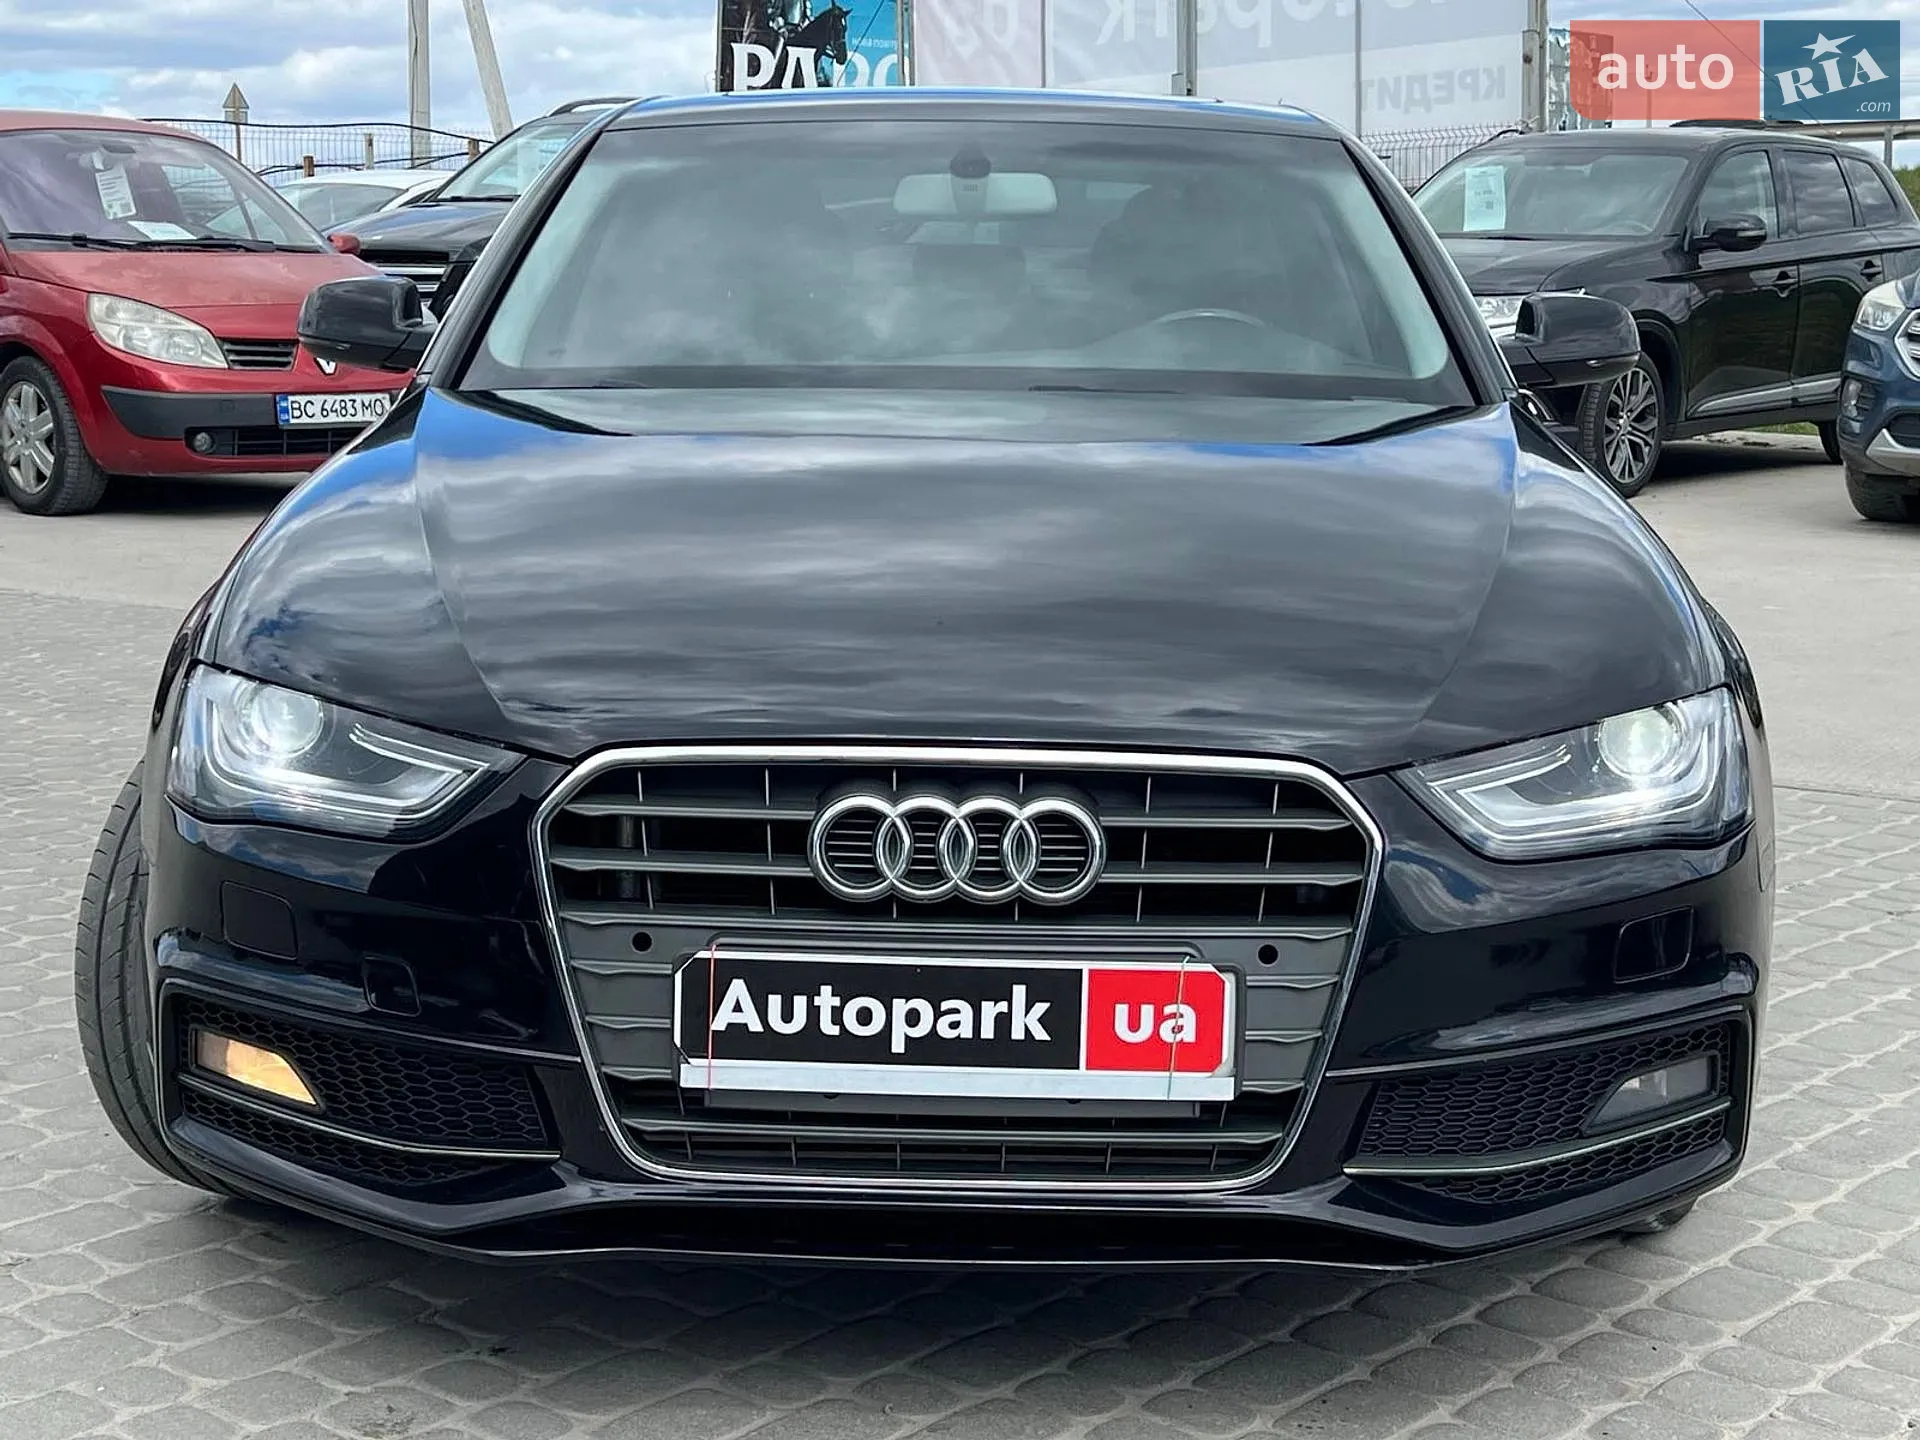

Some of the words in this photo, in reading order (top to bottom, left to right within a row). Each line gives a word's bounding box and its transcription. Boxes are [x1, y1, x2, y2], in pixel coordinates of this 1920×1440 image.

[290, 400, 315, 419] BC
[320, 399, 357, 418] 6483
[361, 398, 385, 418] MO
[711, 978, 1052, 1054] Autopark
[1113, 1003, 1197, 1044] ua
